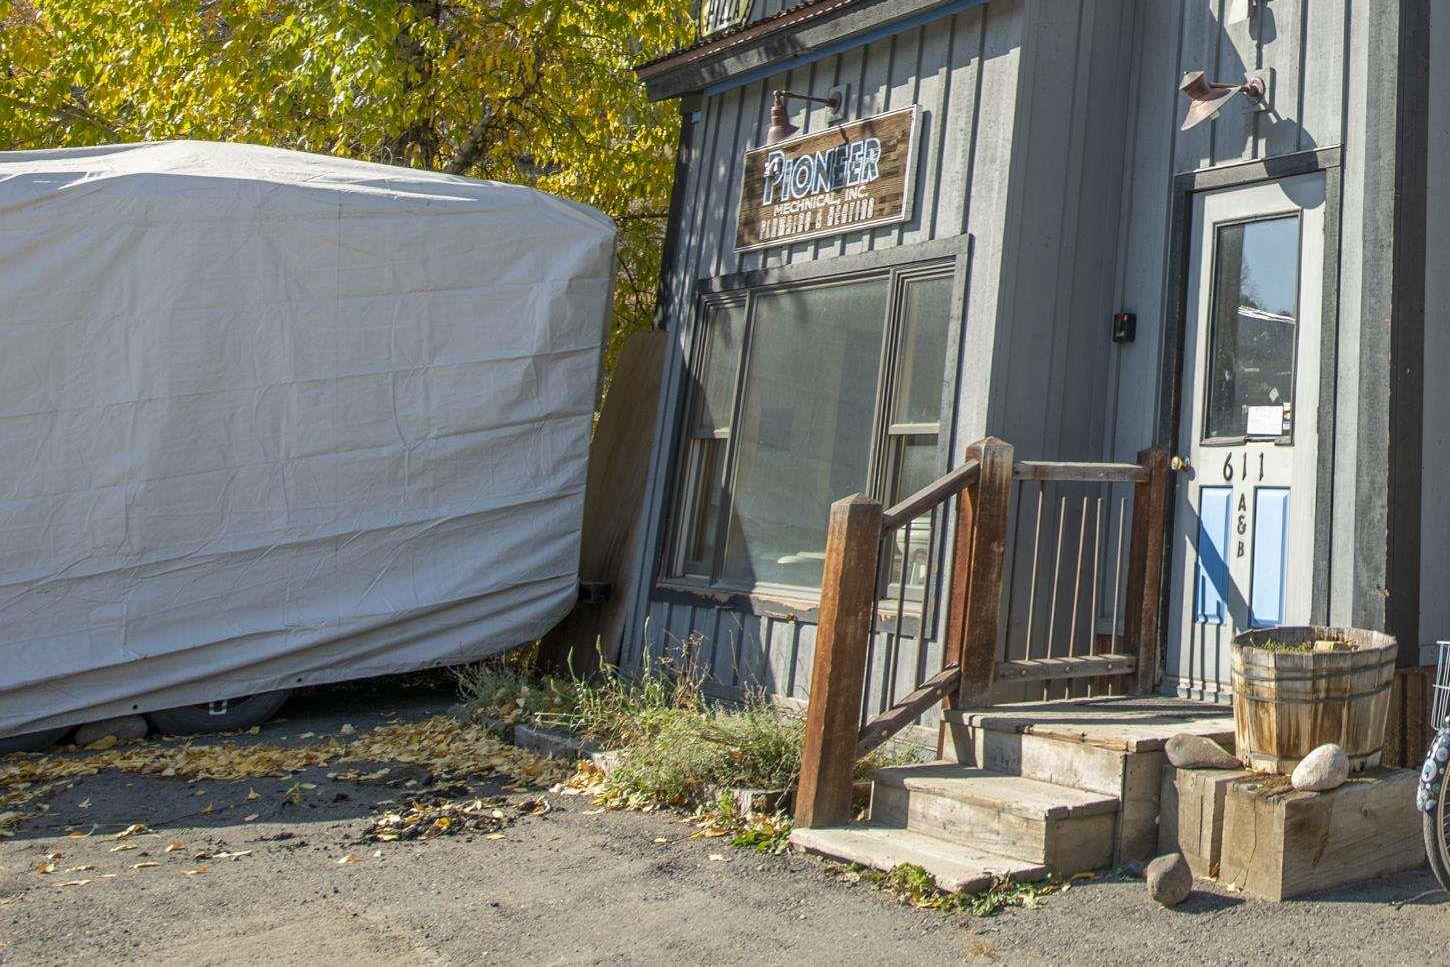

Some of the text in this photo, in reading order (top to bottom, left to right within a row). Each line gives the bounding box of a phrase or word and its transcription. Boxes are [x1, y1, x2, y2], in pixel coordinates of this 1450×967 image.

[762, 137, 881, 206] PIONEER
[844, 185, 869, 202] INC.
[826, 197, 875, 227] HEATING
[1222, 451, 1265, 482] 611
